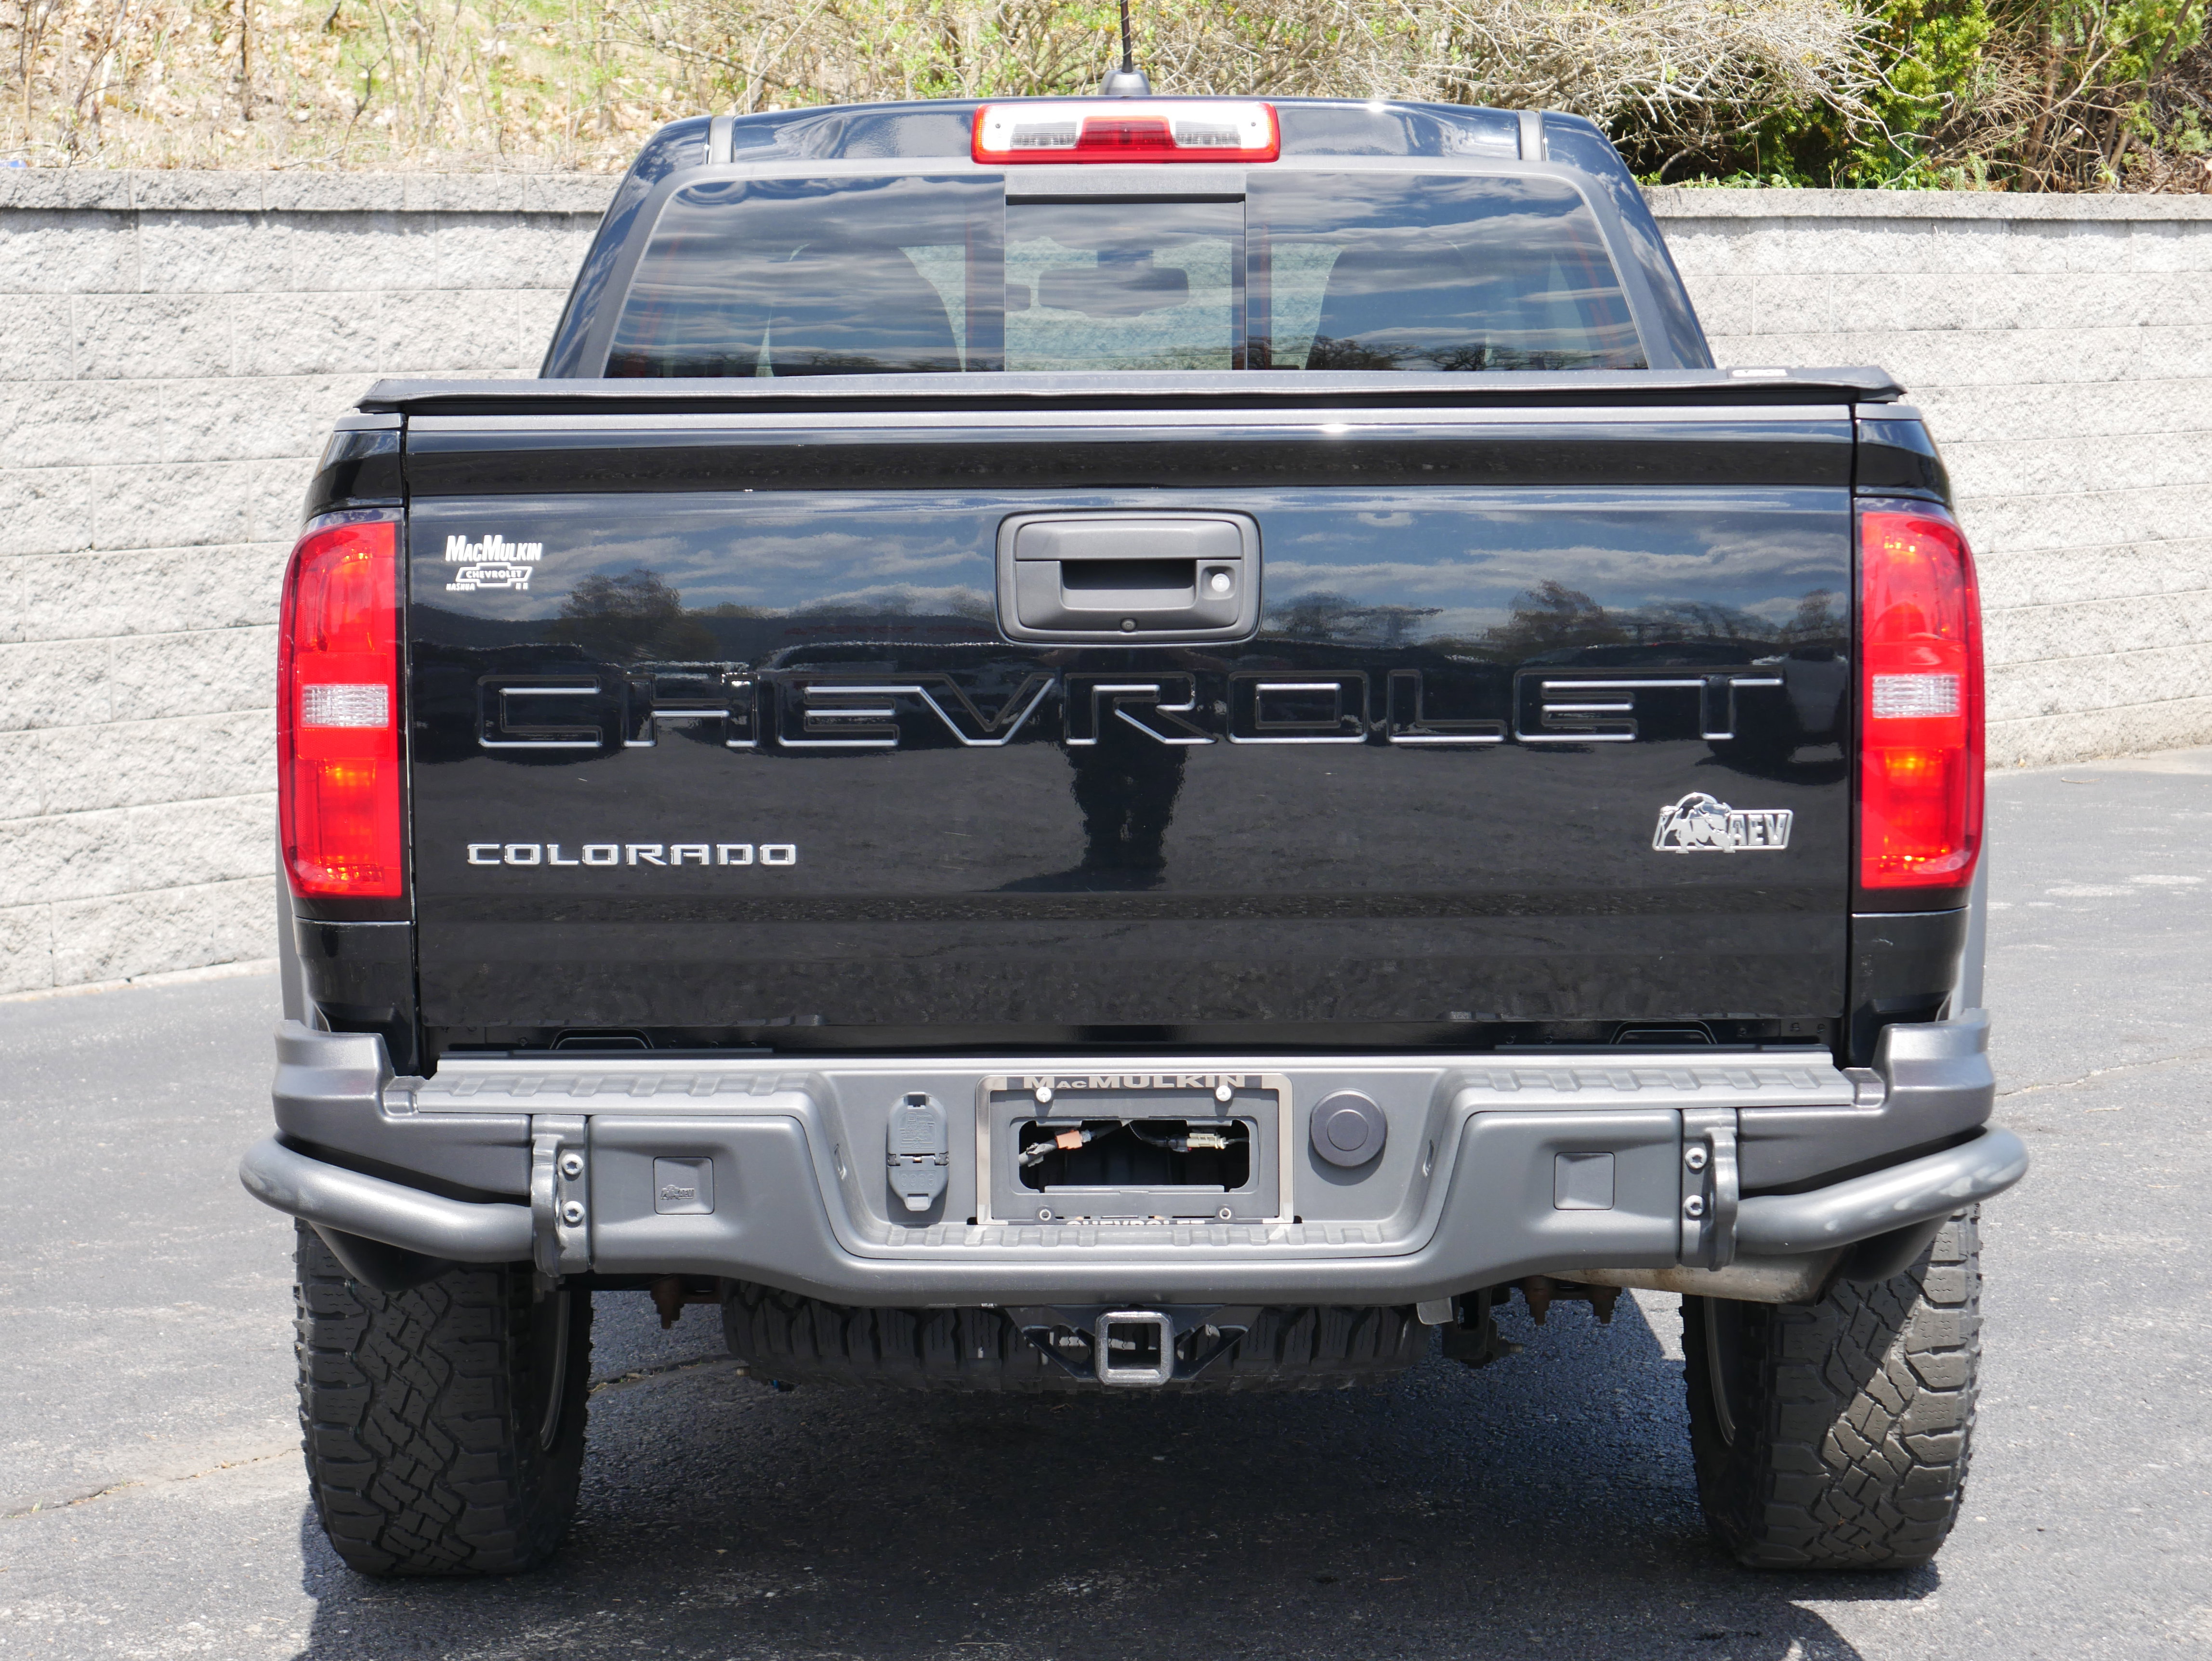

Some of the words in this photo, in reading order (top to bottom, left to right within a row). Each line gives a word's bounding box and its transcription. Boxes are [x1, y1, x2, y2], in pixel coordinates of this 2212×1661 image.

[465, 570, 522, 578] CHEVROLET
[477, 666, 1785, 748] CHEVROLET
[1729, 814, 1788, 845] AEV
[467, 844, 796, 865] COLORADO
